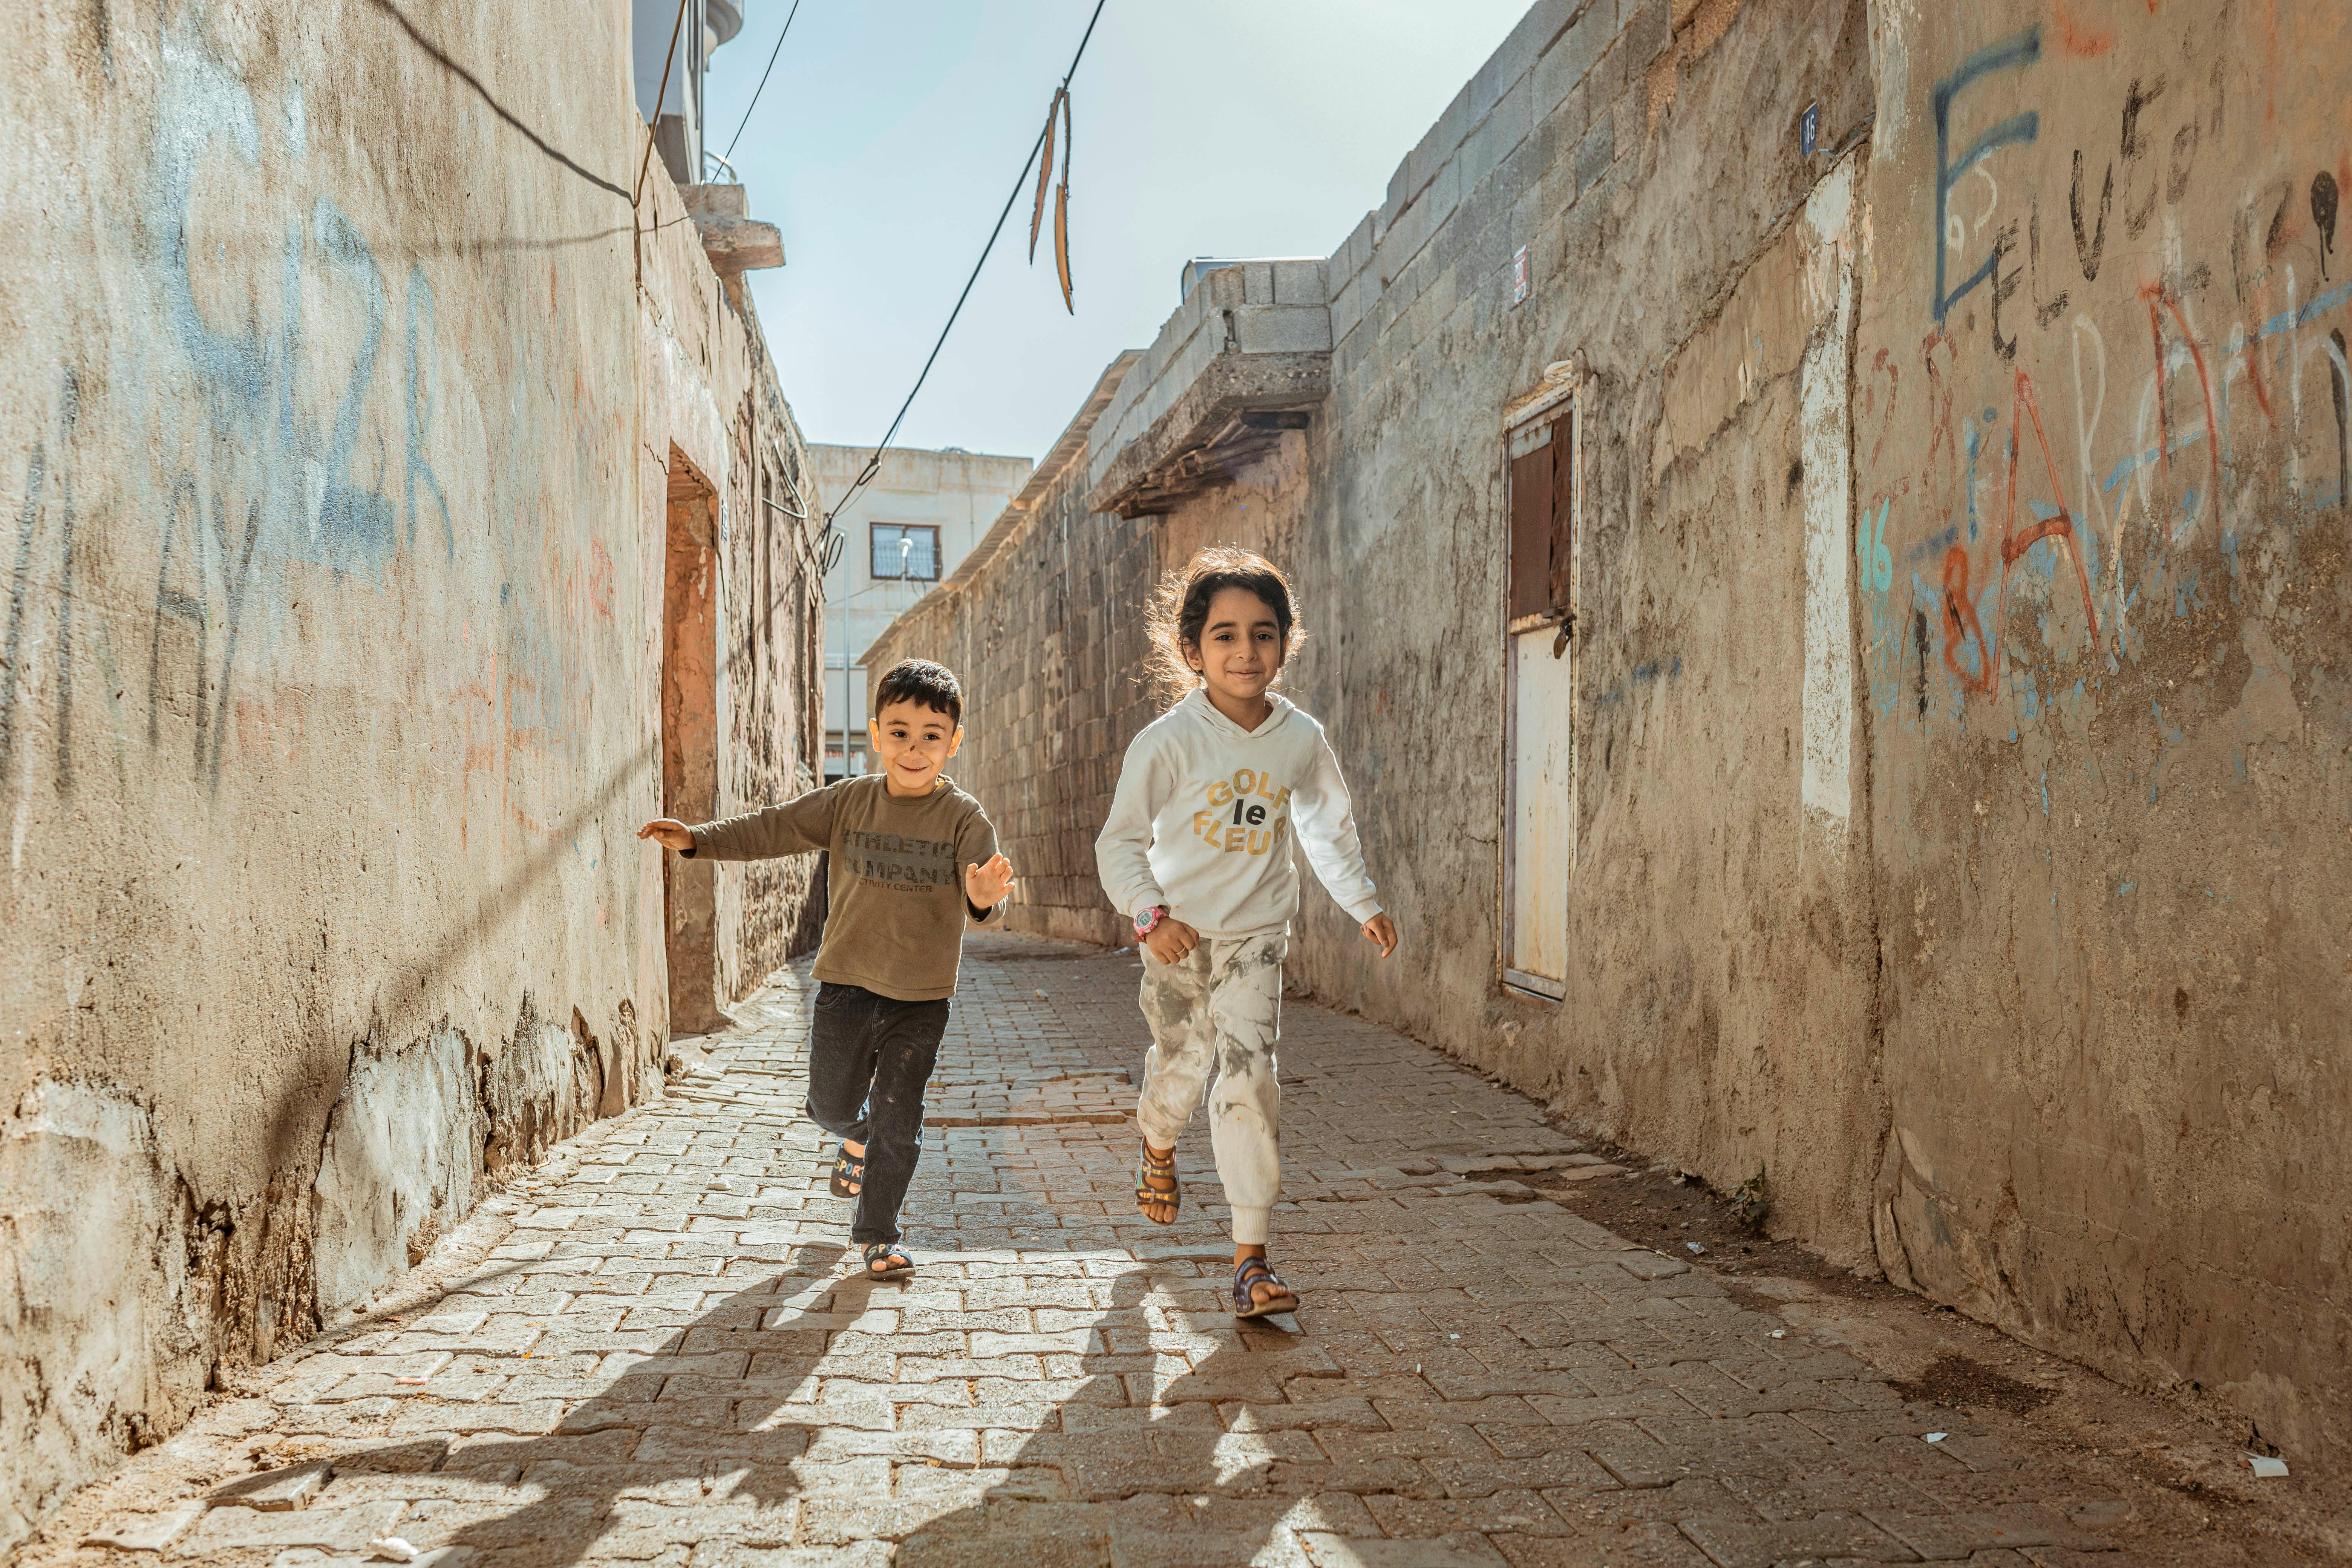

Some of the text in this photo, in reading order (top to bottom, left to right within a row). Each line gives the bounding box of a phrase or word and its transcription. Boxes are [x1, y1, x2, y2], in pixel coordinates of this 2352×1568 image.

[1806, 114, 1815, 144] 16
[1207, 769, 1292, 810] GOLF
[1233, 799, 1266, 825] le
[1194, 811, 1287, 856] FLEUR
[894, 883, 933, 893] CENTER
[834, 1156, 865, 1178] SPOR
